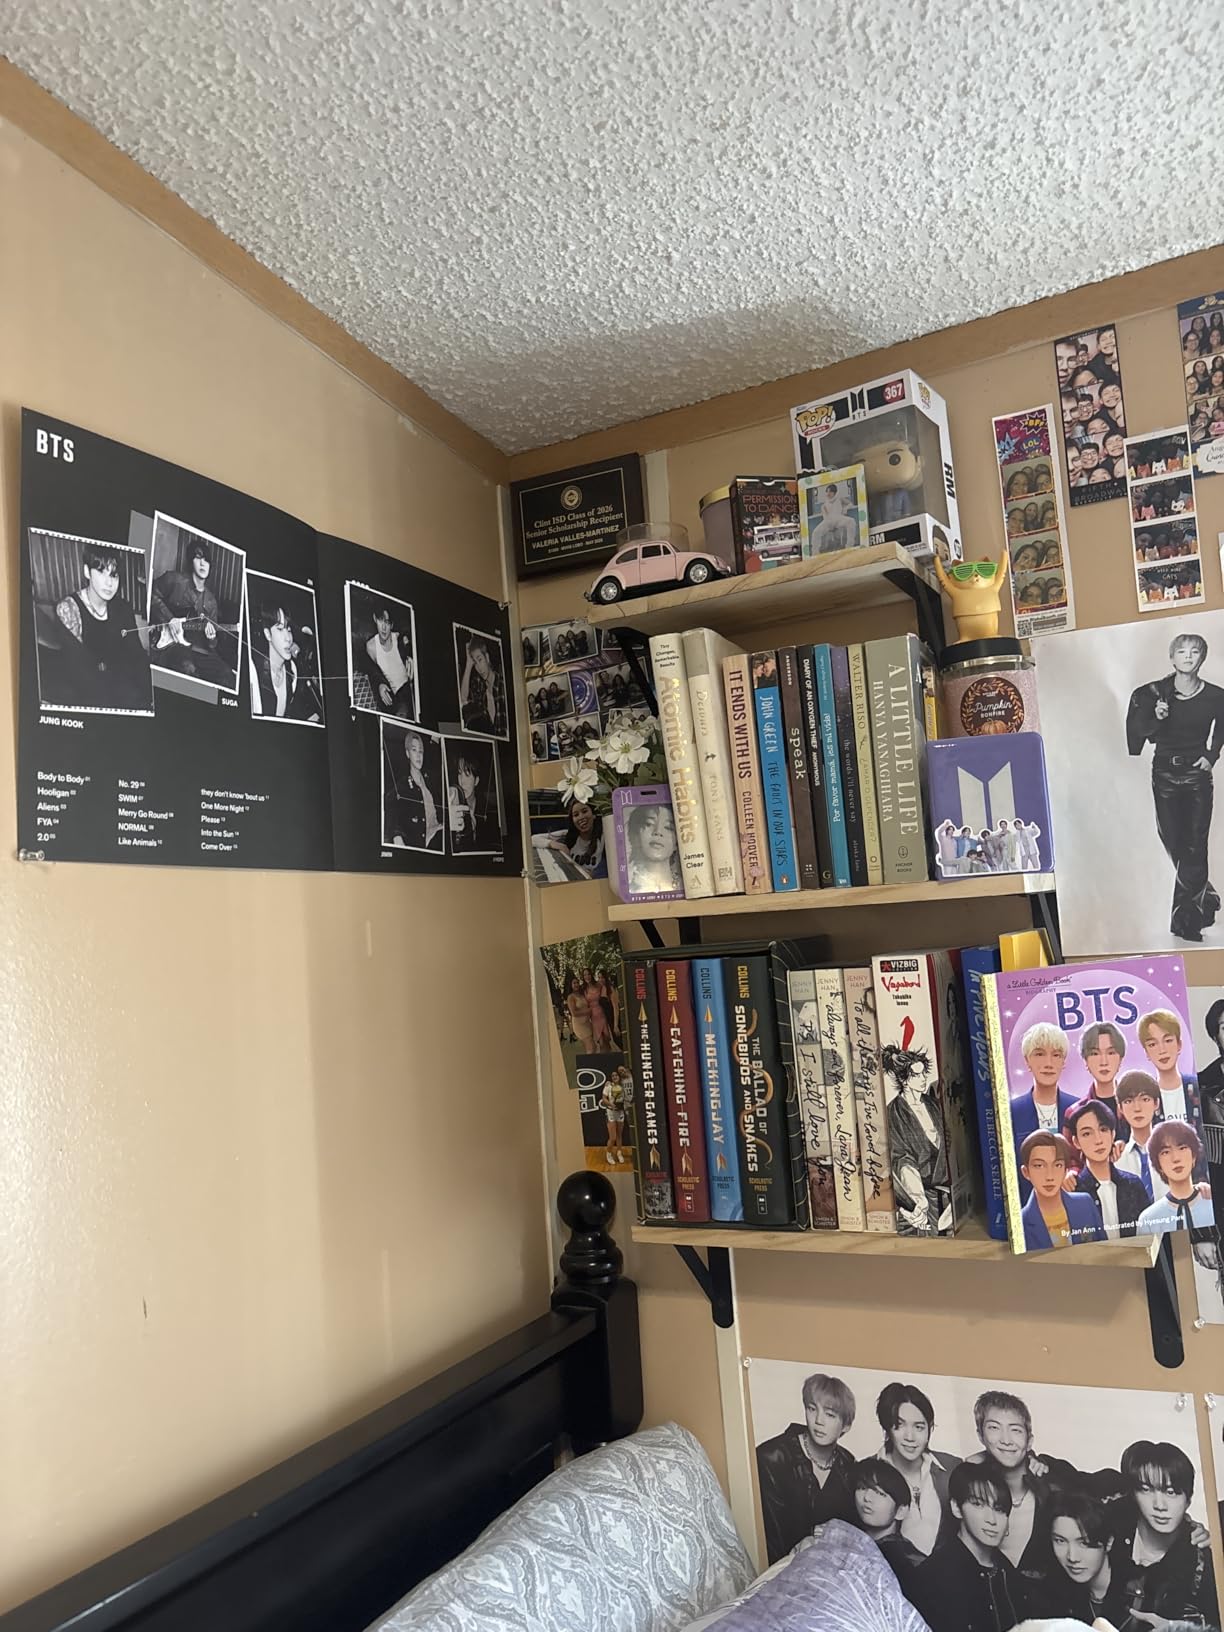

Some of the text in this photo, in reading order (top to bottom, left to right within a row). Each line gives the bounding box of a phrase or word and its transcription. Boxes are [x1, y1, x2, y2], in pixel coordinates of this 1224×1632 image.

[884, 382, 903, 400] 367
[795, 405, 834, 432] POP!
[36, 428, 74, 463] BTS
[1022, 439, 1039, 449] LOL
[944, 462, 956, 499] RM
[742, 495, 798, 504] PERMISSION
[744, 504, 798, 513] TO DANCE
[526, 512, 624, 539] Senior Scholarship Recipient
[534, 504, 614, 529] Clint ISD Class of 2026
[532, 538, 559, 549] VALERIA
[560, 524, 620, 543] VALLES-MARTINEZ
[852, 653, 866, 730] WALTER RISO
[221, 698, 238, 707] SUGA
[803, 658, 818, 749] DIARY OF AN OXYGEN THIEF
[972, 699, 1013, 713] Pumpkin
[39, 716, 84, 729] JUNG KOOK
[729, 670, 752, 779] IT ENDS WITH US
[760, 696, 779, 753] JOHN GREEN
[823, 713, 832, 732] vida!
[980, 710, 1005, 718] BONFIRE
[659, 676, 698, 843] Atomic Habits
[789, 727, 806, 780] speak
[873, 681, 894, 823] HANYA YANAGIHARA
[888, 664, 919, 836] A LITTLE LIFE
[37, 771, 85, 785] Body to Body
[768, 761, 780, 779] THE
[811, 751, 820, 787] ANONYMOUS
[37, 786, 70, 798] Hooligan
[130, 780, 139, 789] 29
[201, 788, 214, 798] they
[214, 790, 228, 798] don't
[229, 791, 244, 799] know
[770, 783, 783, 805] FAULT
[37, 802, 60, 812] Aliens
[118, 793, 138, 803] SWIM
[832, 786, 840, 807] favor
[118, 807, 137, 819] Merry
[138, 809, 148, 818] Go
[148, 810, 168, 820] Round
[201, 801, 213, 810] One
[213, 802, 229, 811] More
[229, 804, 245, 814] Night
[772, 810, 784, 819] IN
[833, 809, 841, 823] Por
[37, 817, 53, 826] FYA
[118, 822, 148, 832] NORMAL
[201, 815, 220, 824] Please
[742, 790, 759, 868] COLLEEN HOOVER
[37, 832, 50, 842] 2.0
[118, 836, 157, 847] Like Animals
[201, 828, 212, 837] Into
[213, 829, 222, 837] the
[222, 830, 234, 838] Sun
[201, 841, 218, 850] Come
[218, 842, 233, 851] Over
[683, 852, 704, 860] James
[775, 839, 789, 867] STARS
[822, 870, 832, 879] G
[890, 960, 918, 968] VIZBIG
[635, 968, 647, 1000] COLLINS
[665, 969, 678, 1001] COLLINS
[700, 967, 712, 1000] COLLINS
[737, 965, 750, 999] COLLINS
[1011, 980, 1029, 989] Little
[1030, 978, 1054, 987] Golden
[1056, 985, 1138, 1031] BTS
[855, 1016, 871, 1037] all
[640, 1023, 658, 1145] THE HUNGER GAMES
[670, 1027, 690, 1148] CATCHING FIRE
[704, 1033, 725, 1144] MOCKINGJAY
[735, 1005, 759, 1172] SONGBIRDS AND SNAKES
[752, 1037, 768, 1135] THE BALLAD OF
[800, 1048, 827, 1151] I still love
[822, 1004, 857, 1202] always forever, Lara Jean
[863, 1122, 881, 1157] loved
[985, 1108, 1001, 1201] REBECCA SERLE
[863, 1158, 884, 1200] before
[1061, 1229, 1070, 1237] By
[1103, 1221, 1135, 1231] Illustrated
[1144, 1216, 1170, 1226] Hyesung
